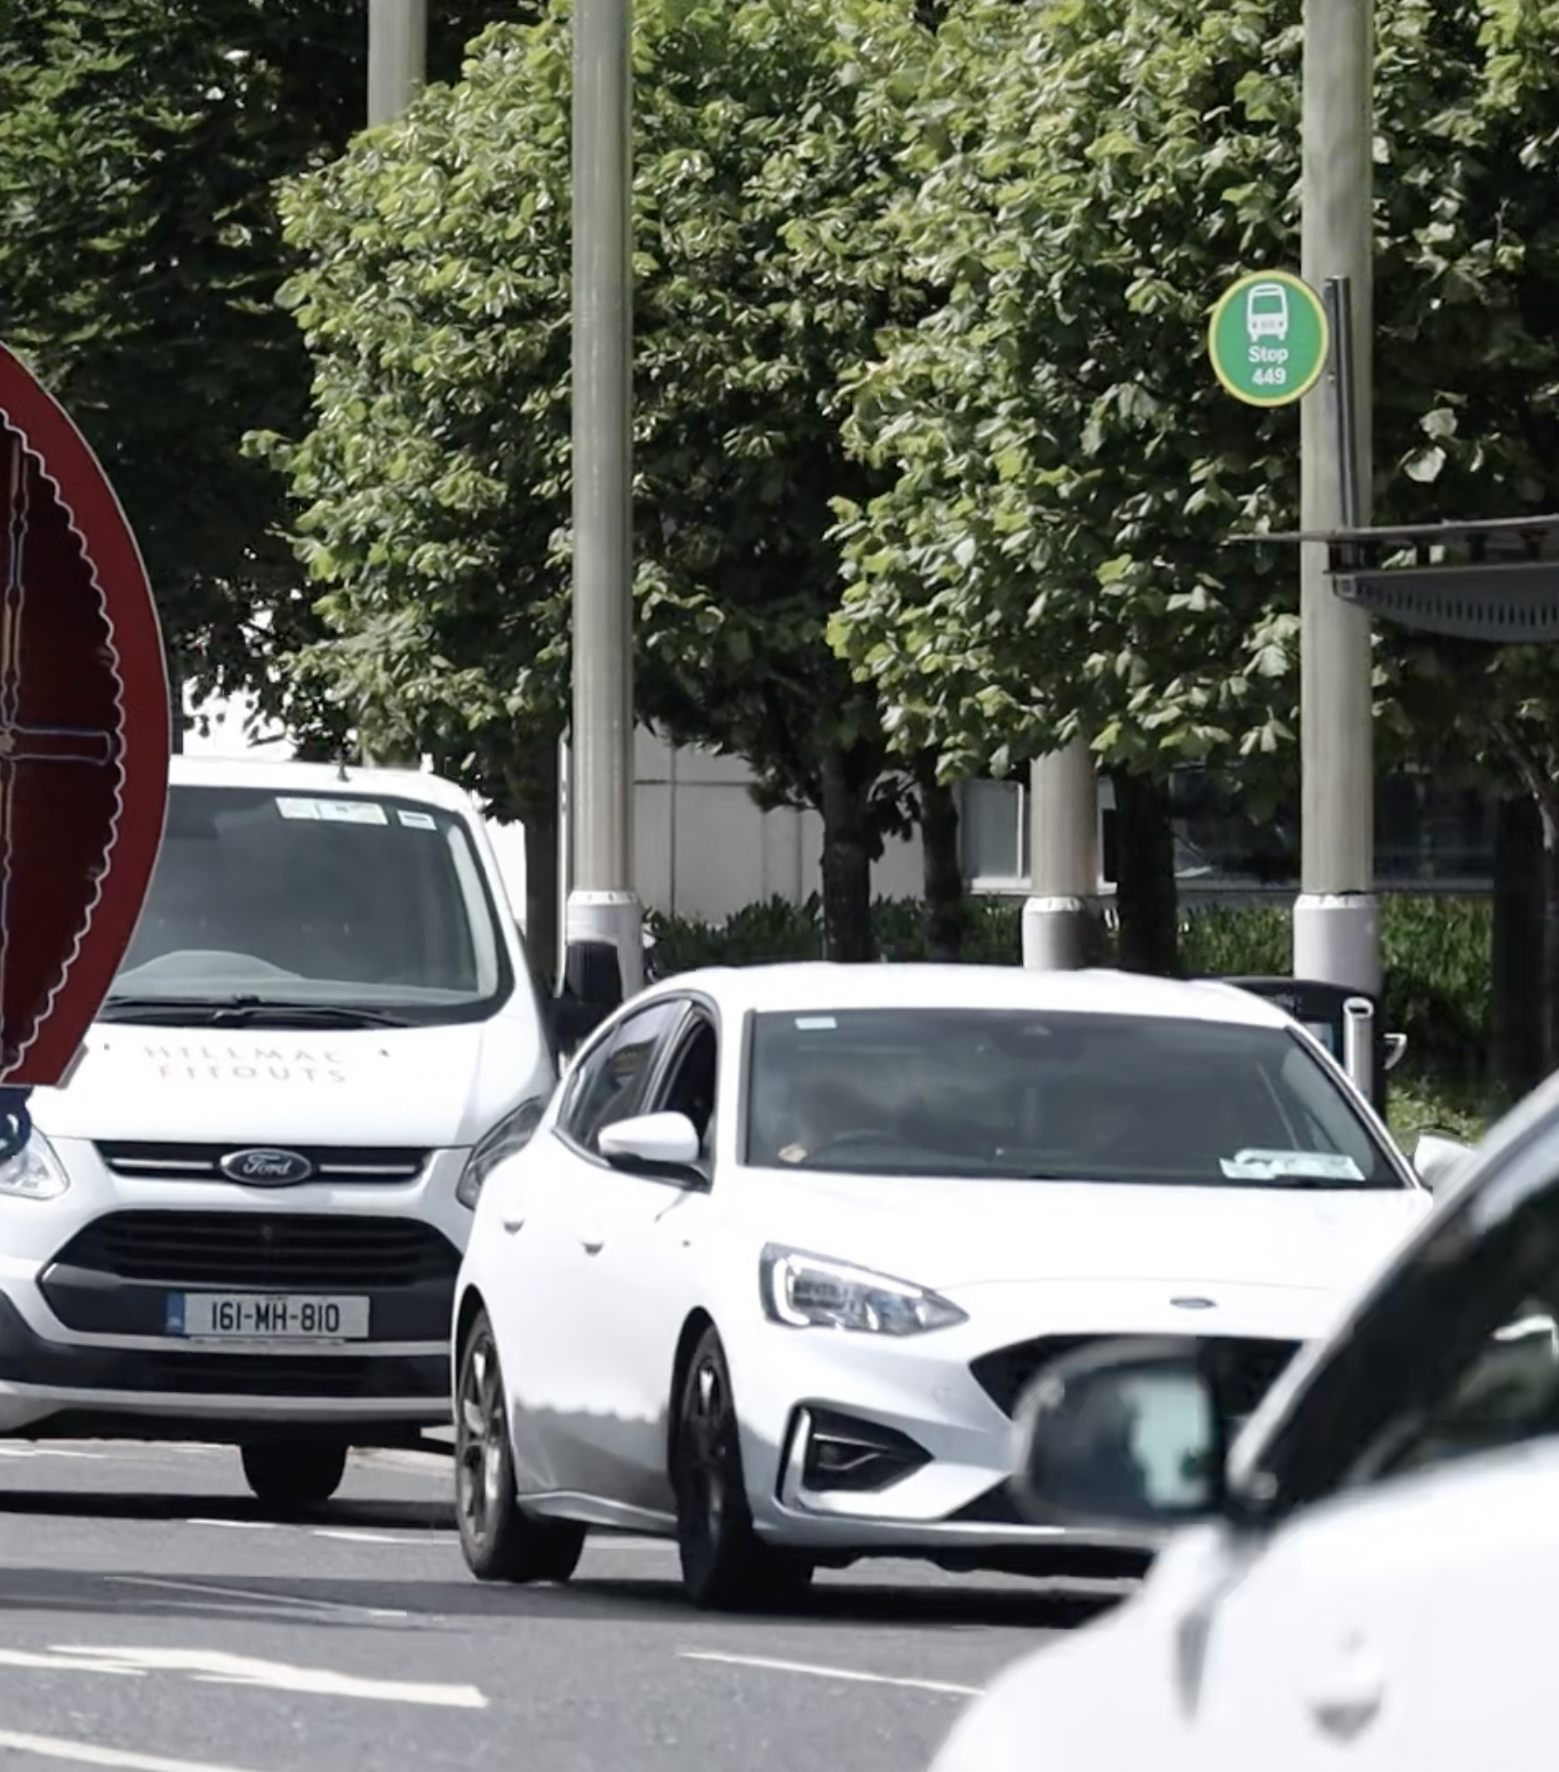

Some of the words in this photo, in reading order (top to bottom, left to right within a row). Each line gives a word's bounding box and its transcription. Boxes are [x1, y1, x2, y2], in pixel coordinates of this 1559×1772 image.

[1248, 345, 1289, 364] Stop
[1252, 368, 1287, 385] 449
[159, 1065, 346, 1083] FITOUTS
[243, 1153, 293, 1176] Ford
[211, 1301, 341, 1332] 161-MH-810
